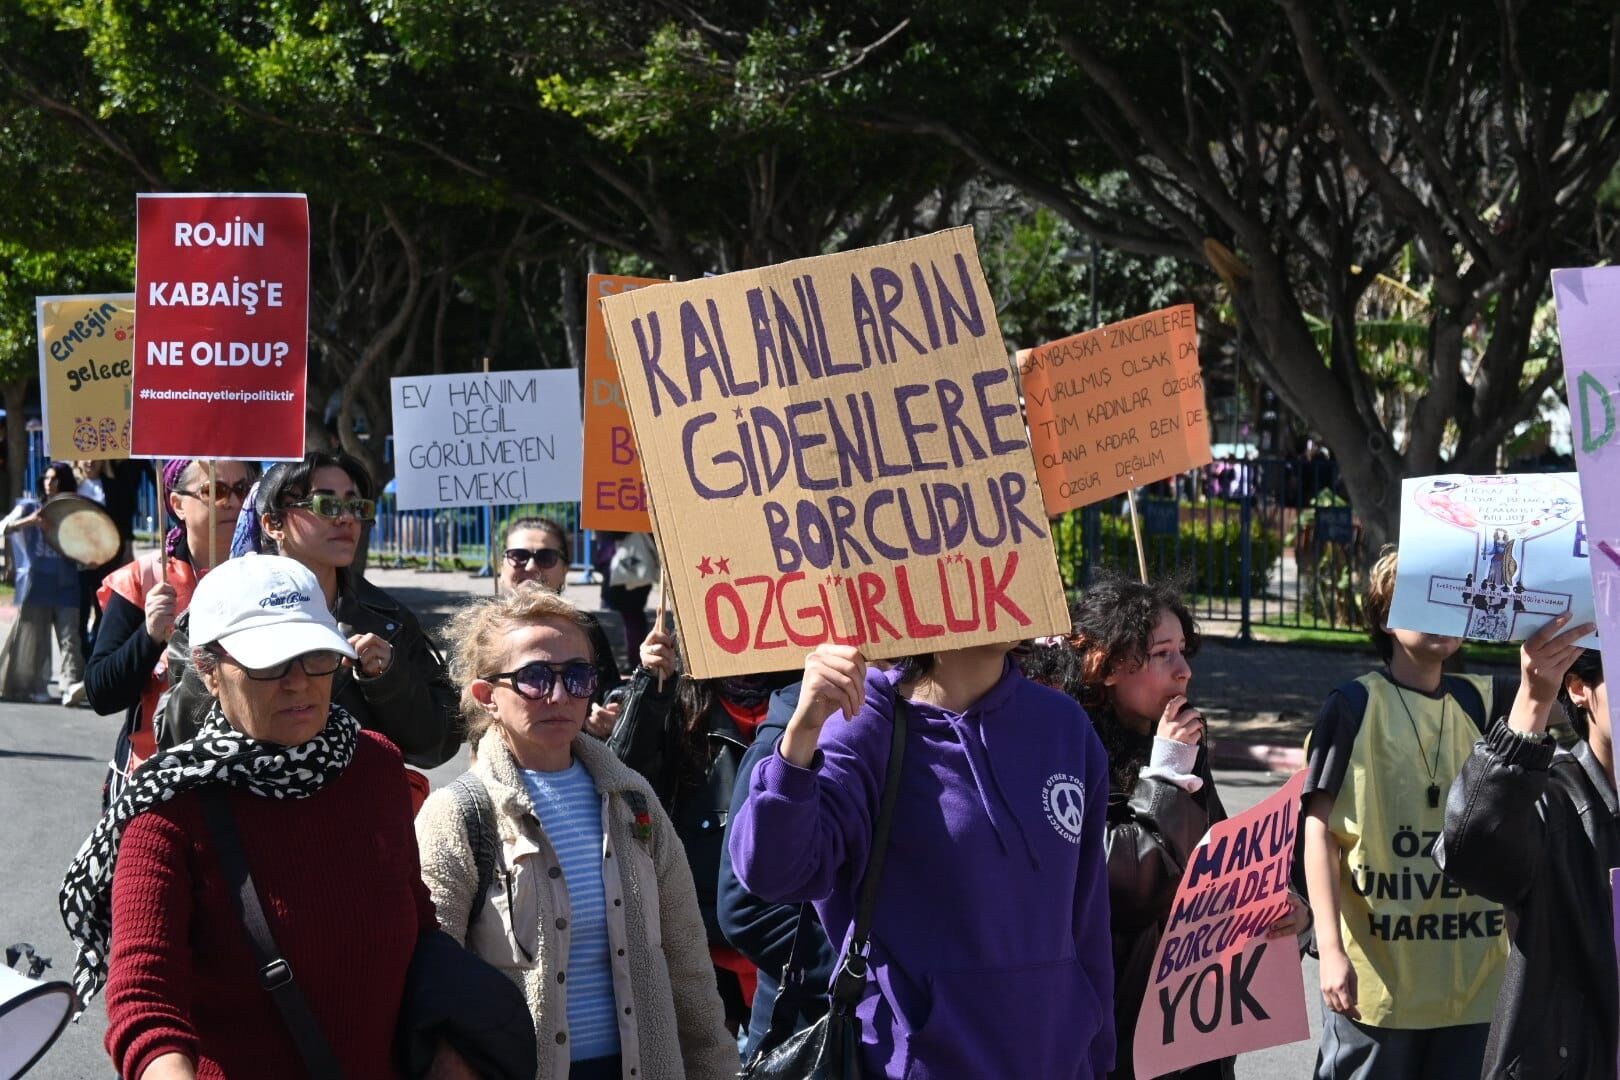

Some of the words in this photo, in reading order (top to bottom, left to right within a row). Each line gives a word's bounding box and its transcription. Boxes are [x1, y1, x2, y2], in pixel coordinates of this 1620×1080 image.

[175, 215, 265, 247] ROJİN
[149, 275, 283, 315] KABAİŞ'E
[631, 253, 986, 417] KALANLARIN
[147, 341, 184, 366] NE
[190, 341, 289, 367] OLDU?
[1019, 336, 1102, 376] BAMBAŞKA
[66, 359, 132, 392] gelece
[402, 384, 432, 409] EV
[449, 378, 537, 407] HANIMI
[1029, 367, 1112, 415] VURULMUŞ
[1121, 351, 1171, 377] OLSAK
[1178, 341, 1197, 360] DA
[139, 388, 295, 404] #kadıncinayetleripolitiktir
[1039, 412, 1080, 441] TÜM
[1087, 388, 1152, 428] KADINLAR
[409, 434, 555, 469] GÖRÜLMEYEN
[682, 367, 1028, 500] GİDENLERE
[1042, 444, 1087, 469] OLANA
[1096, 427, 1140, 452] KADAR
[1149, 415, 1180, 439] BEN
[1185, 409, 1203, 427] DE
[763, 471, 1047, 574] BORCUDUR
[696, 550, 1033, 656] ÖZGÜRLÜK
[1046, 773, 1068, 787] OTHER
[1041, 787, 1051, 812] EACH
[1047, 814, 1076, 844] PROTECT
[1188, 797, 1295, 890] MAKUL
[1391, 825, 1443, 858] ÖZ
[1367, 909, 1505, 942] HAREKE
[1159, 942, 1272, 1046] YOK
